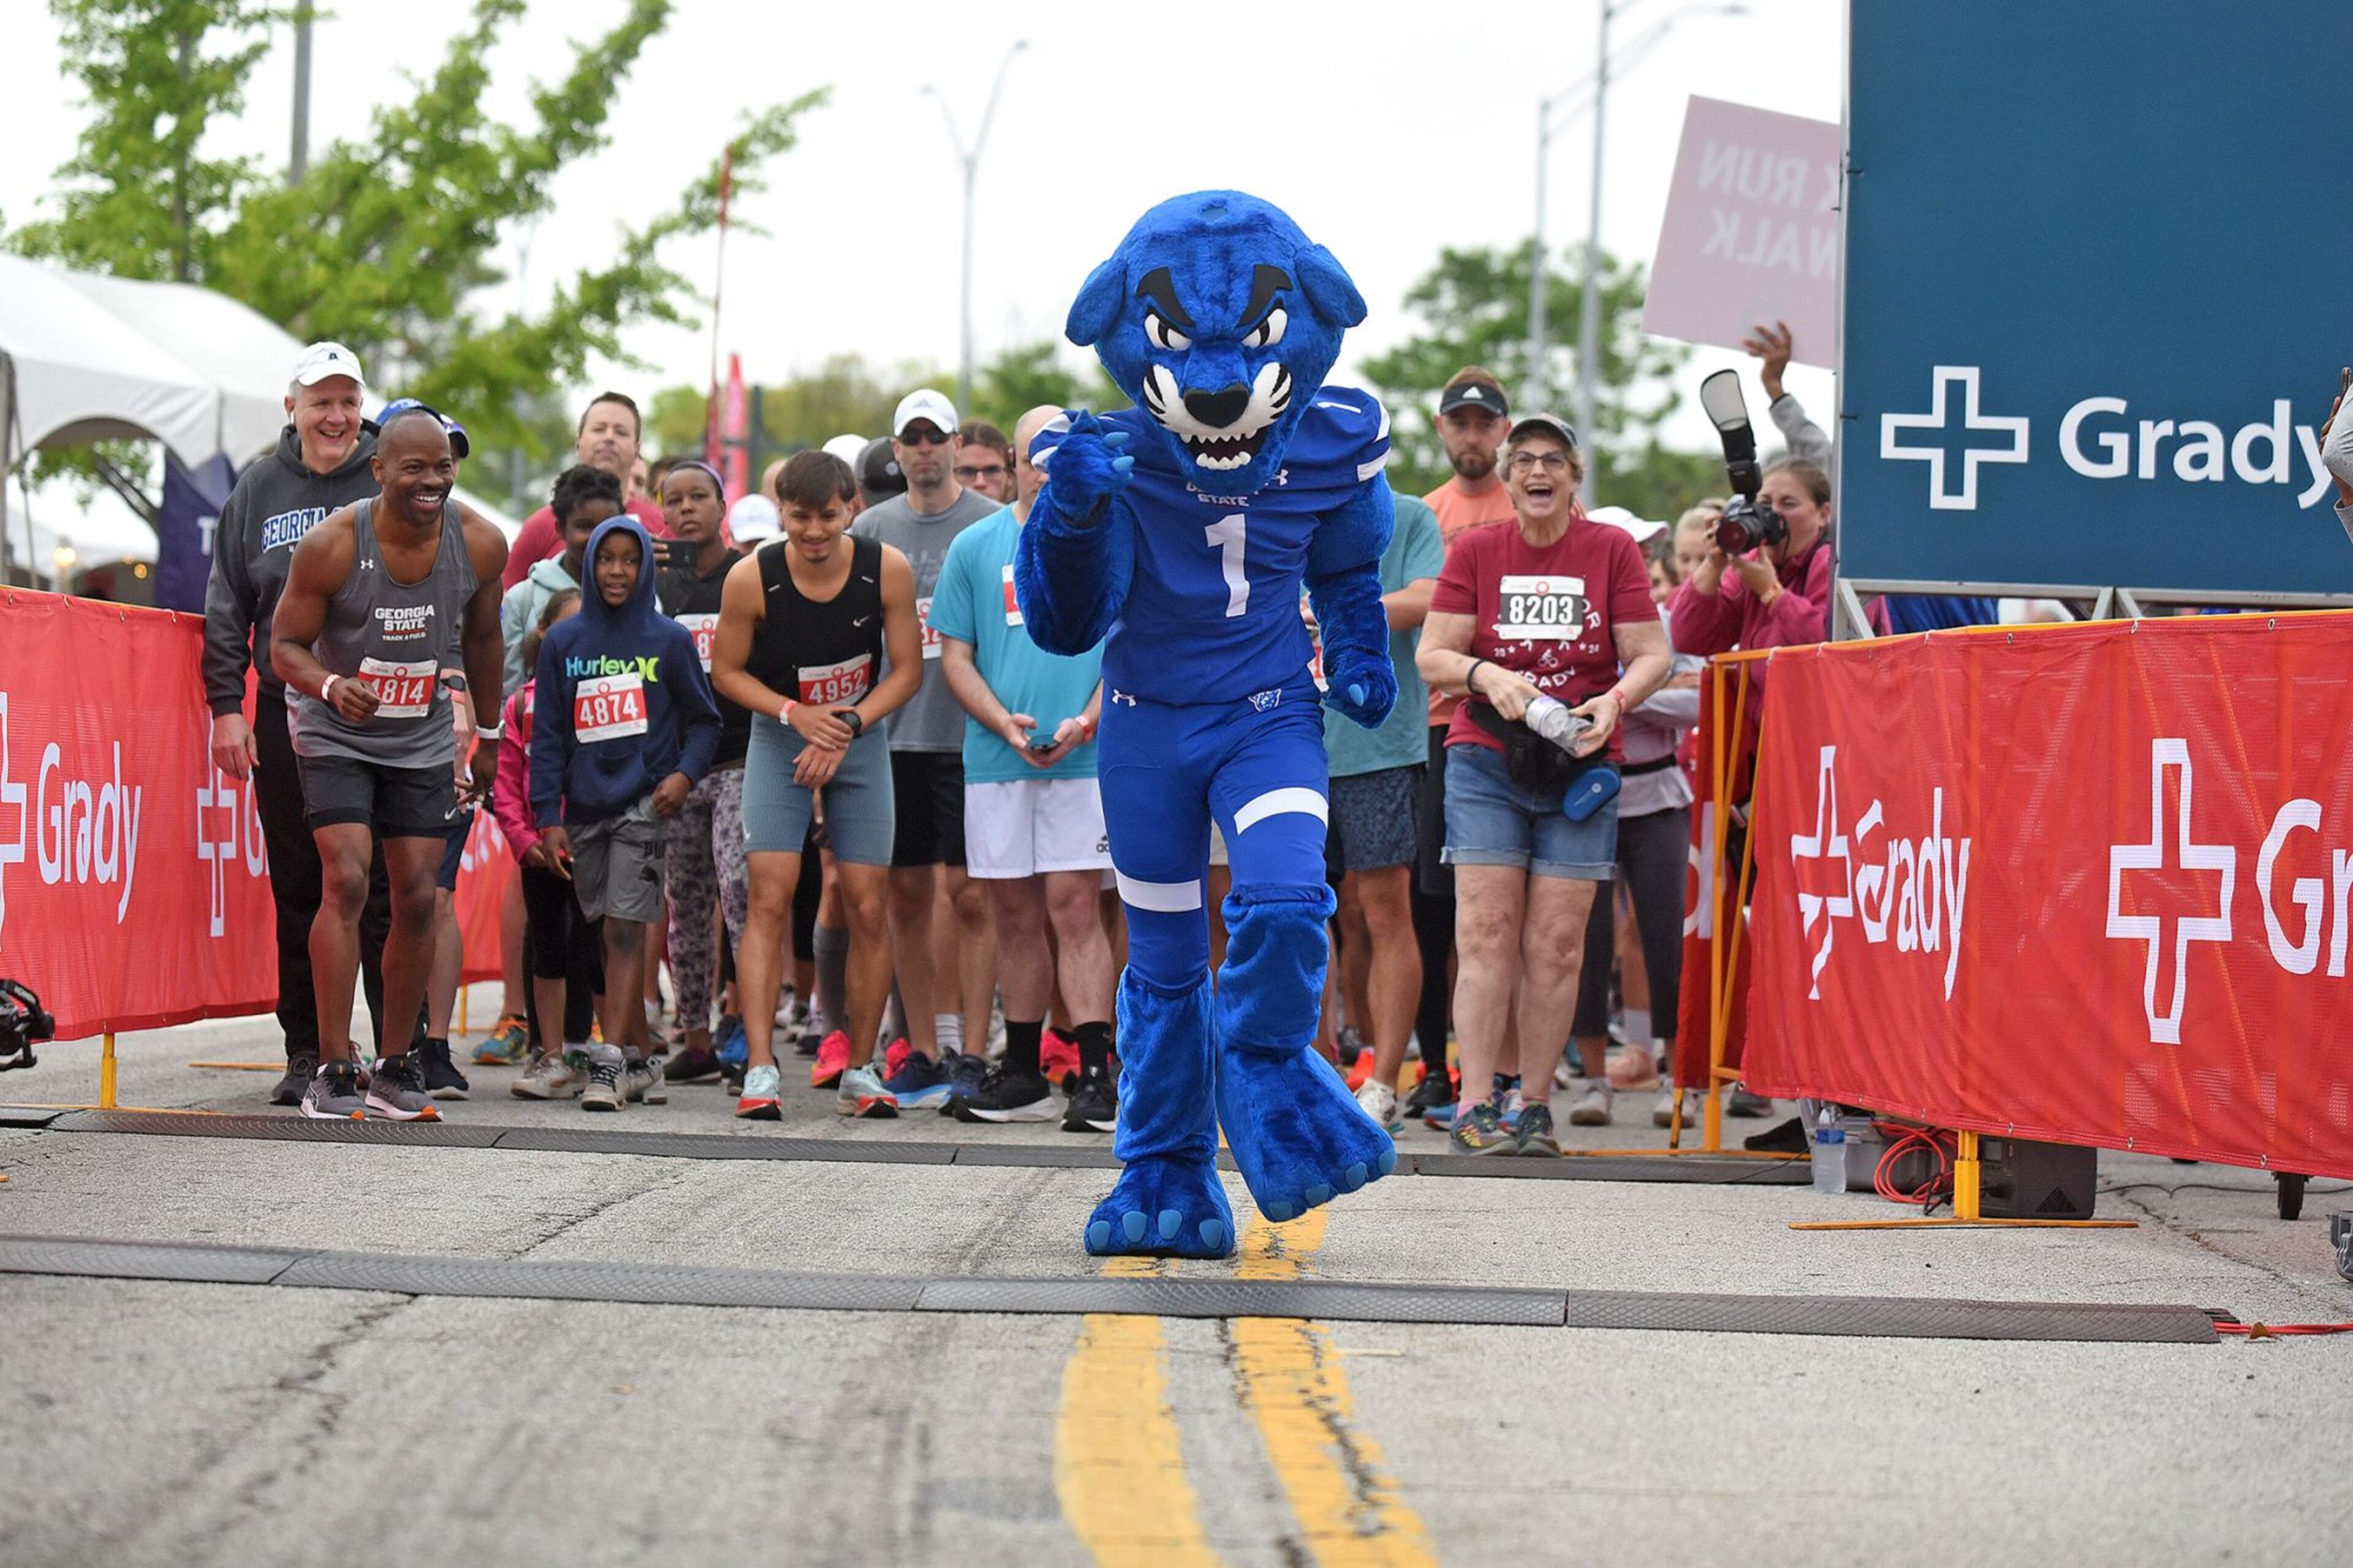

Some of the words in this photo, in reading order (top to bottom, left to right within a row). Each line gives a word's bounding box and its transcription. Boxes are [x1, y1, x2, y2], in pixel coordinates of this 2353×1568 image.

[2058, 396, 2333, 510] Grady
[1197, 493, 1249, 507] STATE
[1205, 513, 1251, 618] 1
[374, 604, 435, 620] GEORGIA
[384, 616, 426, 632] STATE
[1509, 595, 1574, 624] 8203
[566, 654, 636, 677] Hurley
[1516, 665, 1575, 688] RADY
[809, 668, 864, 704] 4952
[580, 691, 638, 727] 4874
[37, 741, 142, 925] Grady
